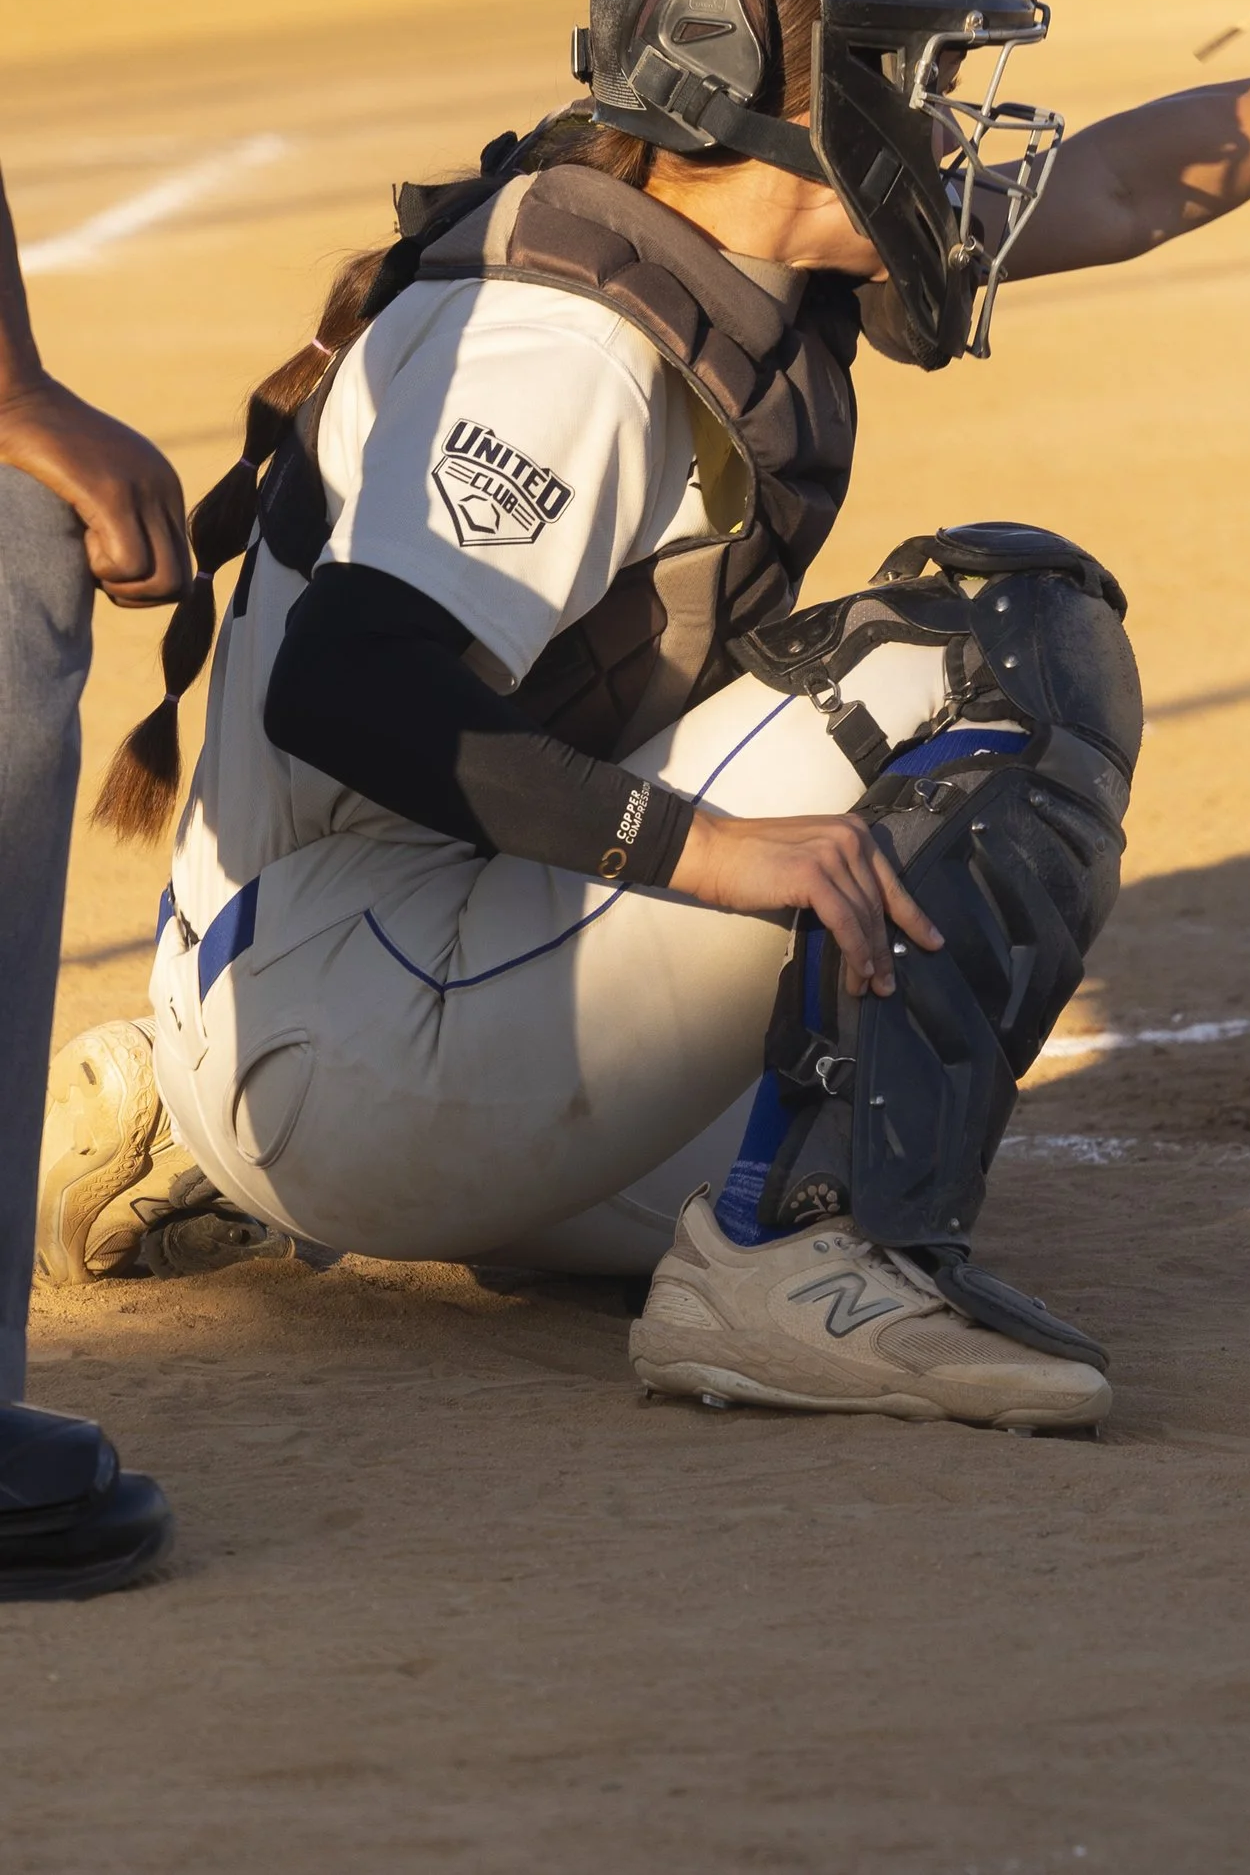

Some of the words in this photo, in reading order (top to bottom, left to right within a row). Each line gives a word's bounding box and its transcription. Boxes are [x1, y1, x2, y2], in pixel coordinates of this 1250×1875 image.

[445, 421, 572, 520] UNITED
[470, 472, 519, 514] CLUB
[616, 789, 641, 840] COPPER
